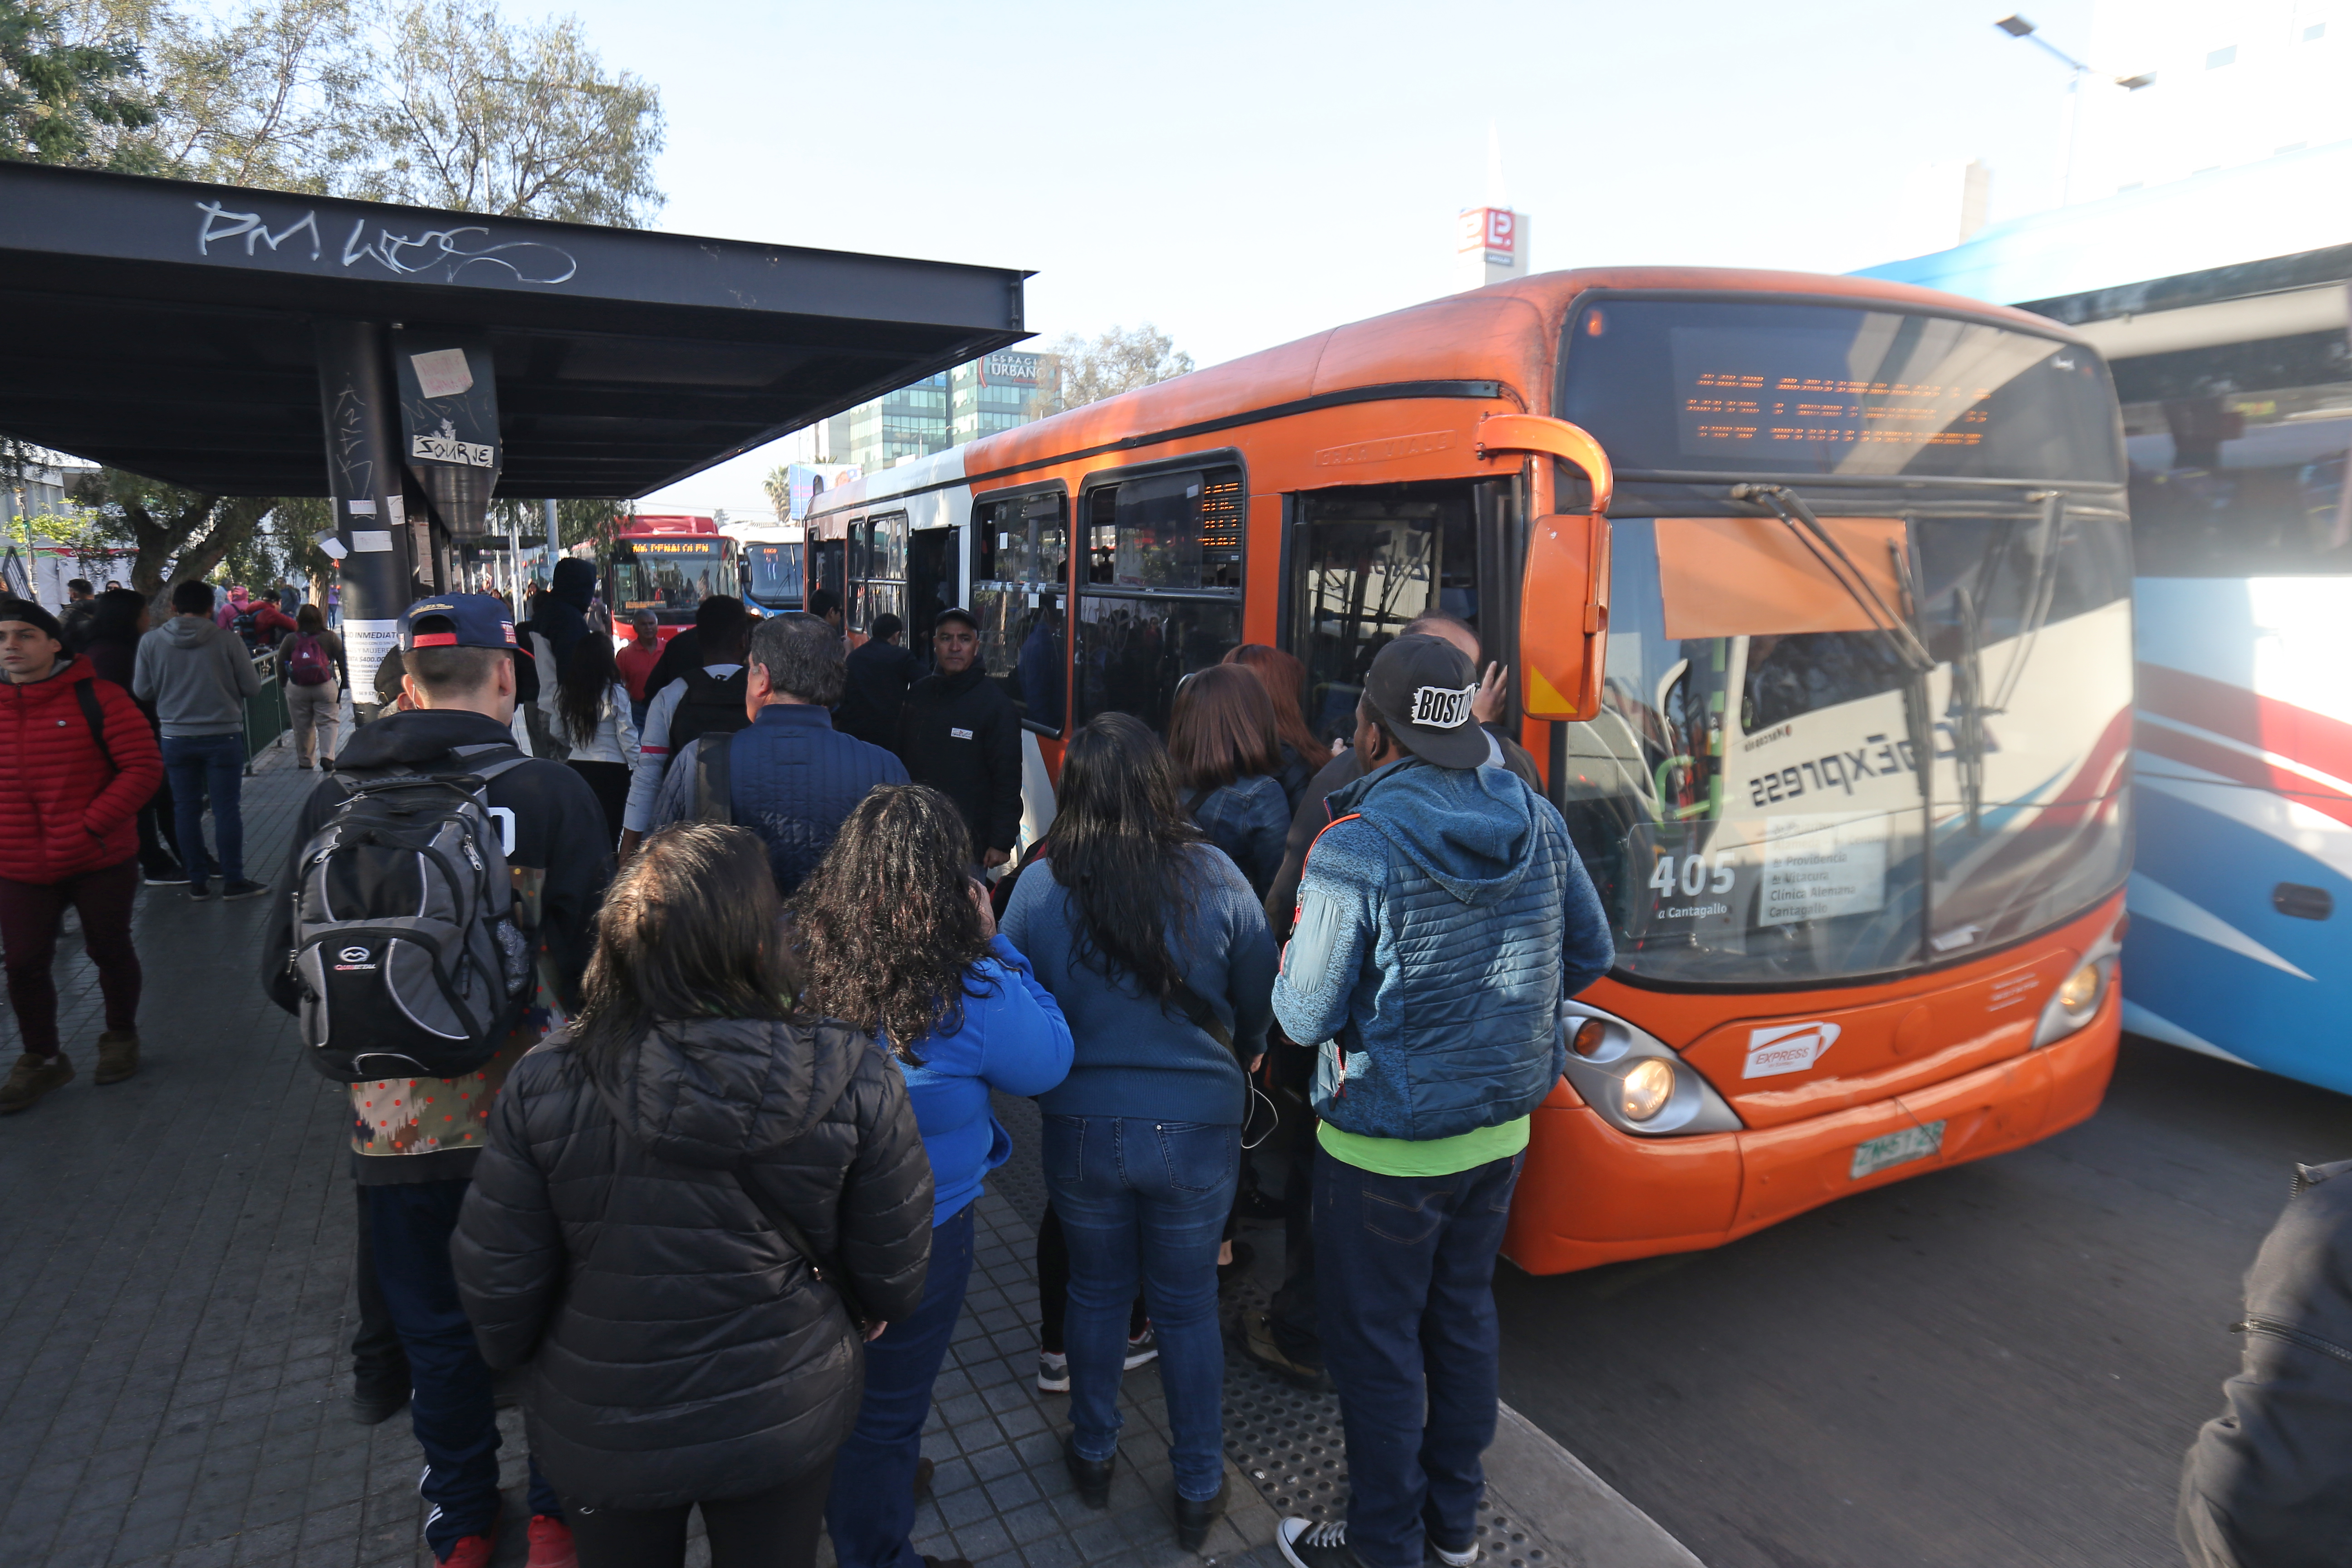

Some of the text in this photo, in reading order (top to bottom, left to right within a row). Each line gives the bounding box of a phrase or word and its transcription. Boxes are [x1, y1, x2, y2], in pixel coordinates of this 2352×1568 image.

[1786, 851, 1848, 866] Providencia
[1650, 852, 1736, 898] 405
[1785, 871, 1829, 883] Vitacura
[1770, 885, 1856, 901] Clínica Alemana
[1668, 902, 1728, 919] Cantagallo
[1769, 902, 1828, 919] Cantagallo
[1755, 1047, 1810, 1065] EXPRESS
